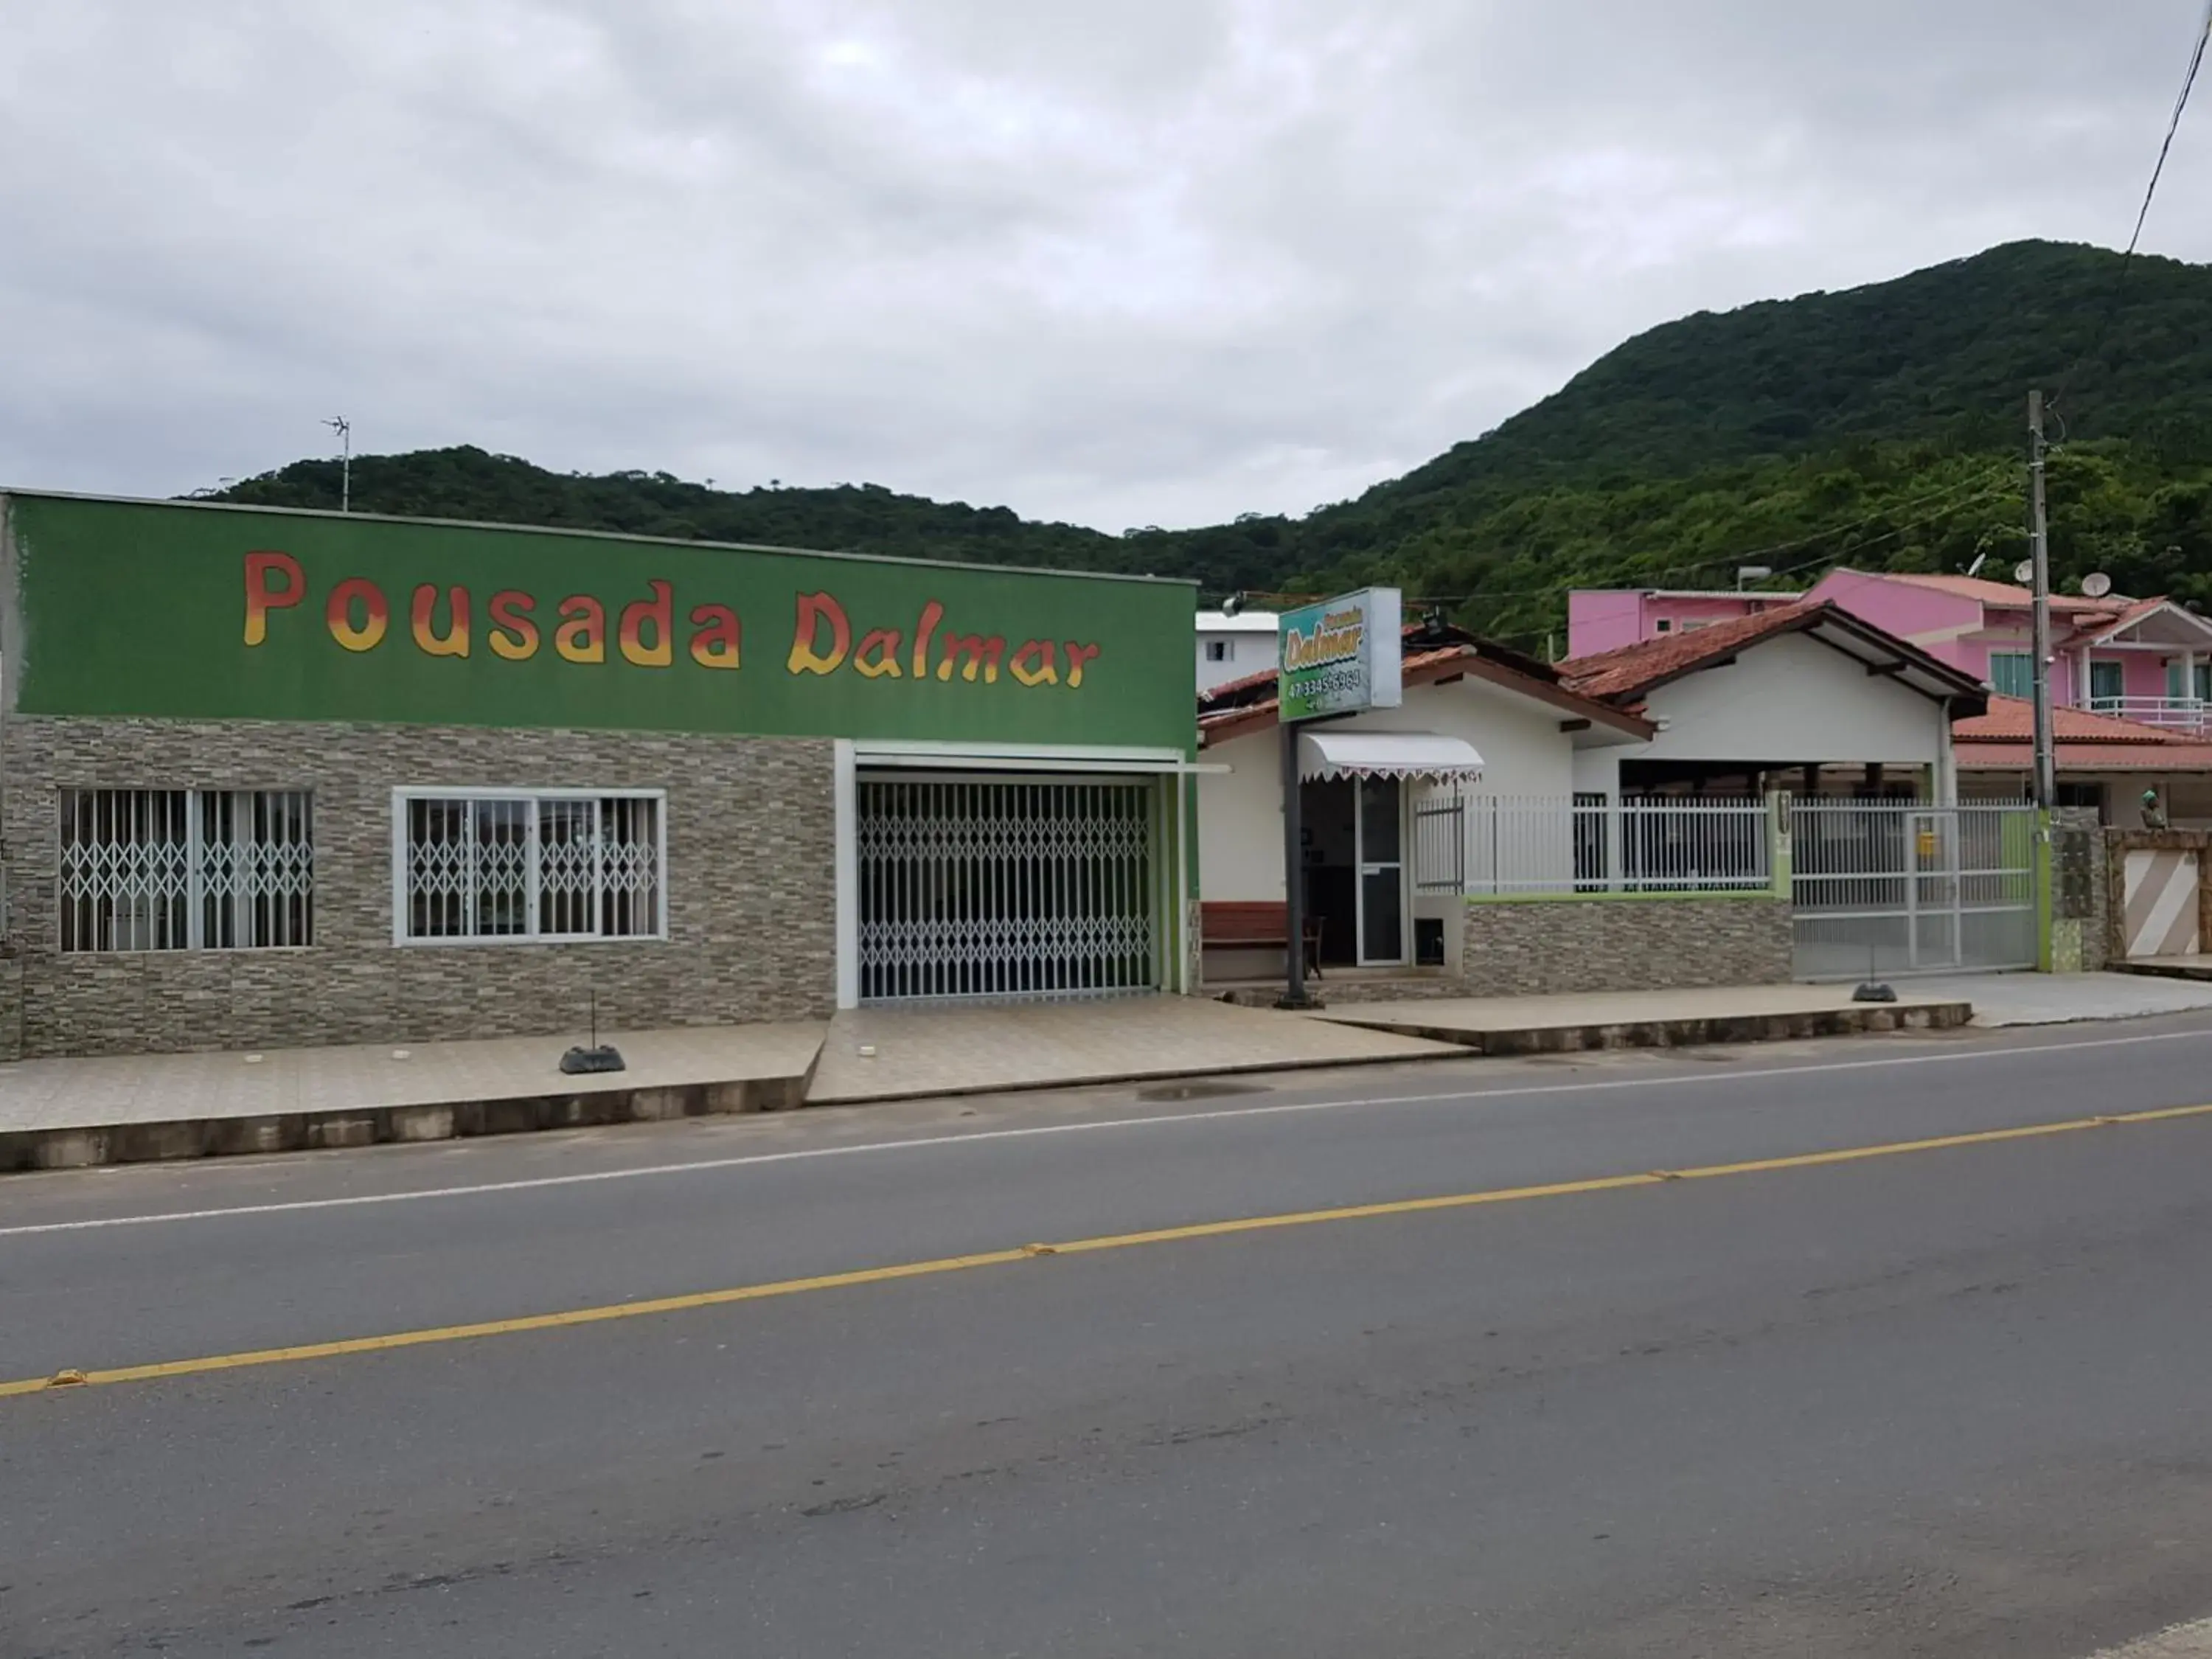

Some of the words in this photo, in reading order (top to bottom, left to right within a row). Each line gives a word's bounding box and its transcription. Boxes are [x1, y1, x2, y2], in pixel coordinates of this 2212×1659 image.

[243, 550, 741, 669] Pousada
[786, 589, 1100, 689] Dalmar
[1285, 623, 1363, 671] Dalmar
